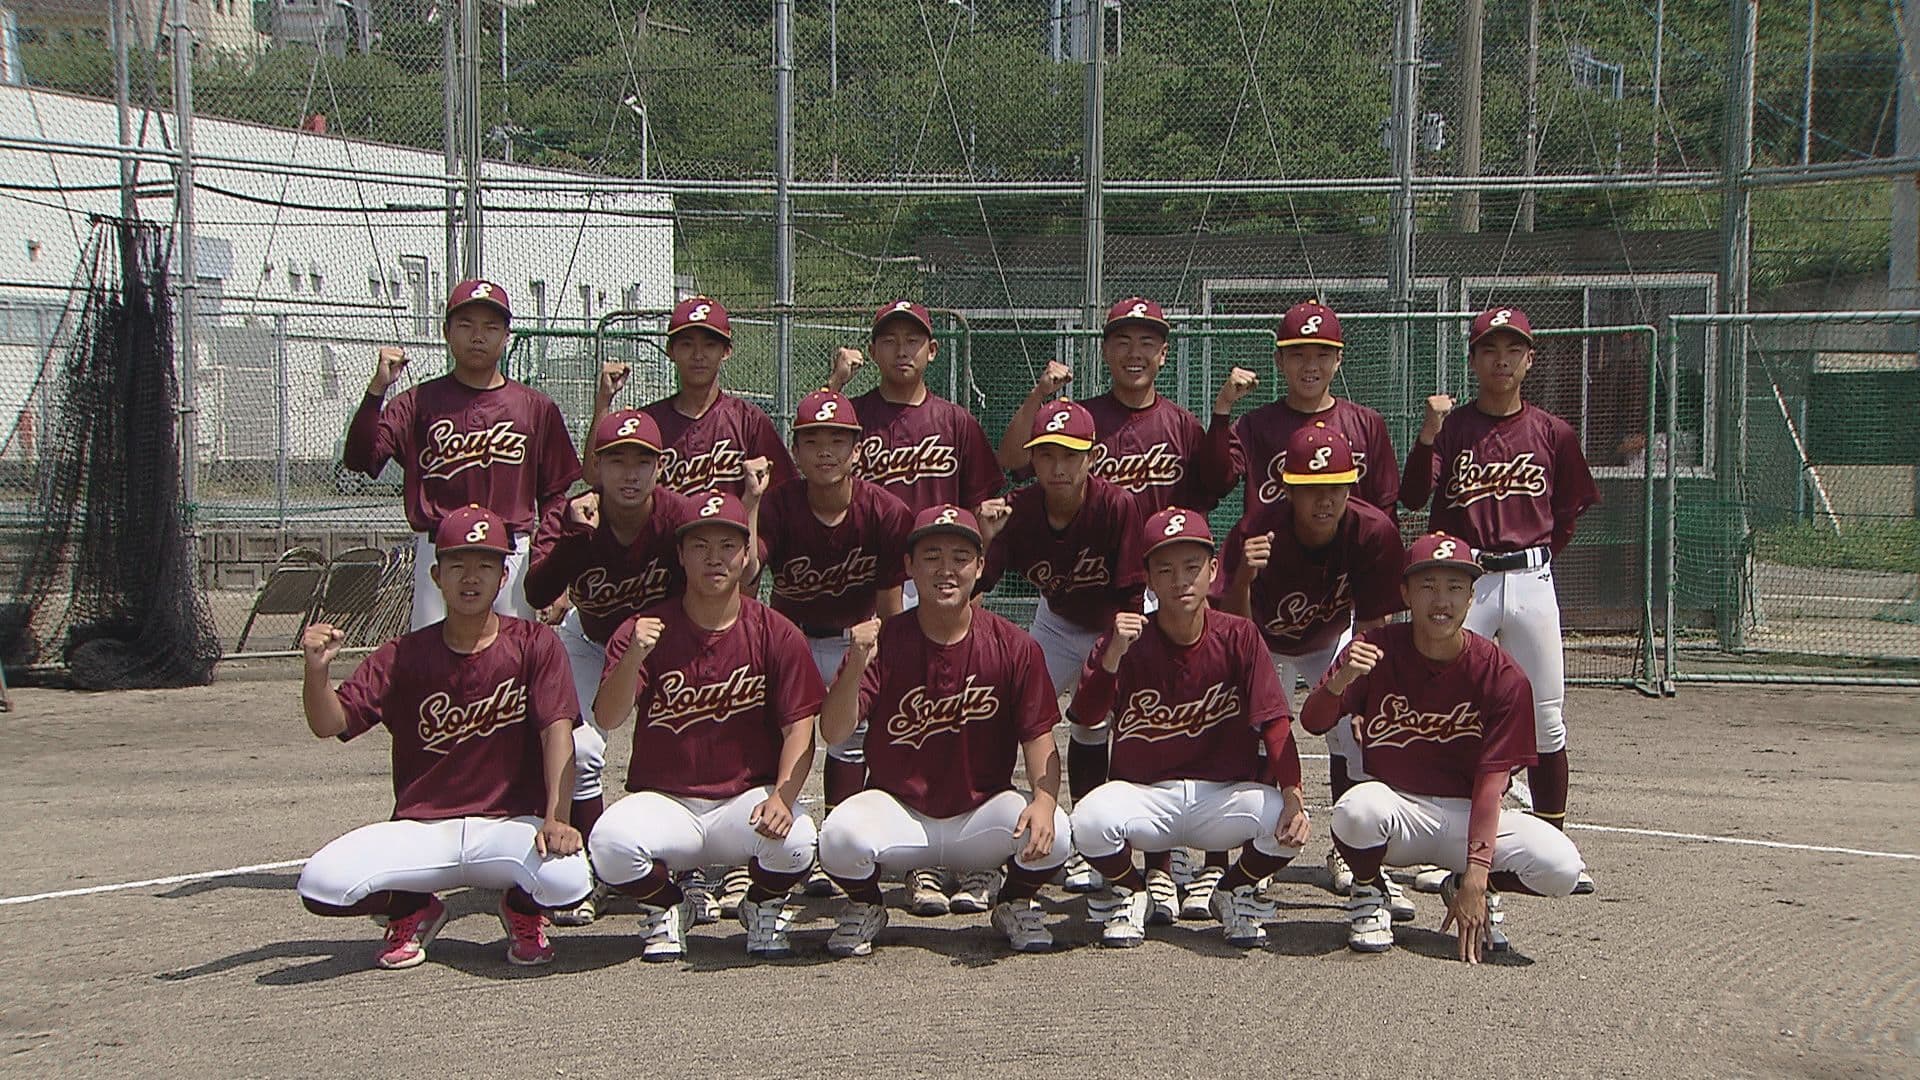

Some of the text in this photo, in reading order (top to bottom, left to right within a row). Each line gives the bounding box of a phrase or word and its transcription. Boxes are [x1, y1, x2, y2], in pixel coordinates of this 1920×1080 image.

[1301, 315, 1323, 335] S
[815, 401, 838, 422] S
[1045, 410, 1071, 433] S
[1308, 446, 1332, 471] S
[465, 521, 490, 543] S
